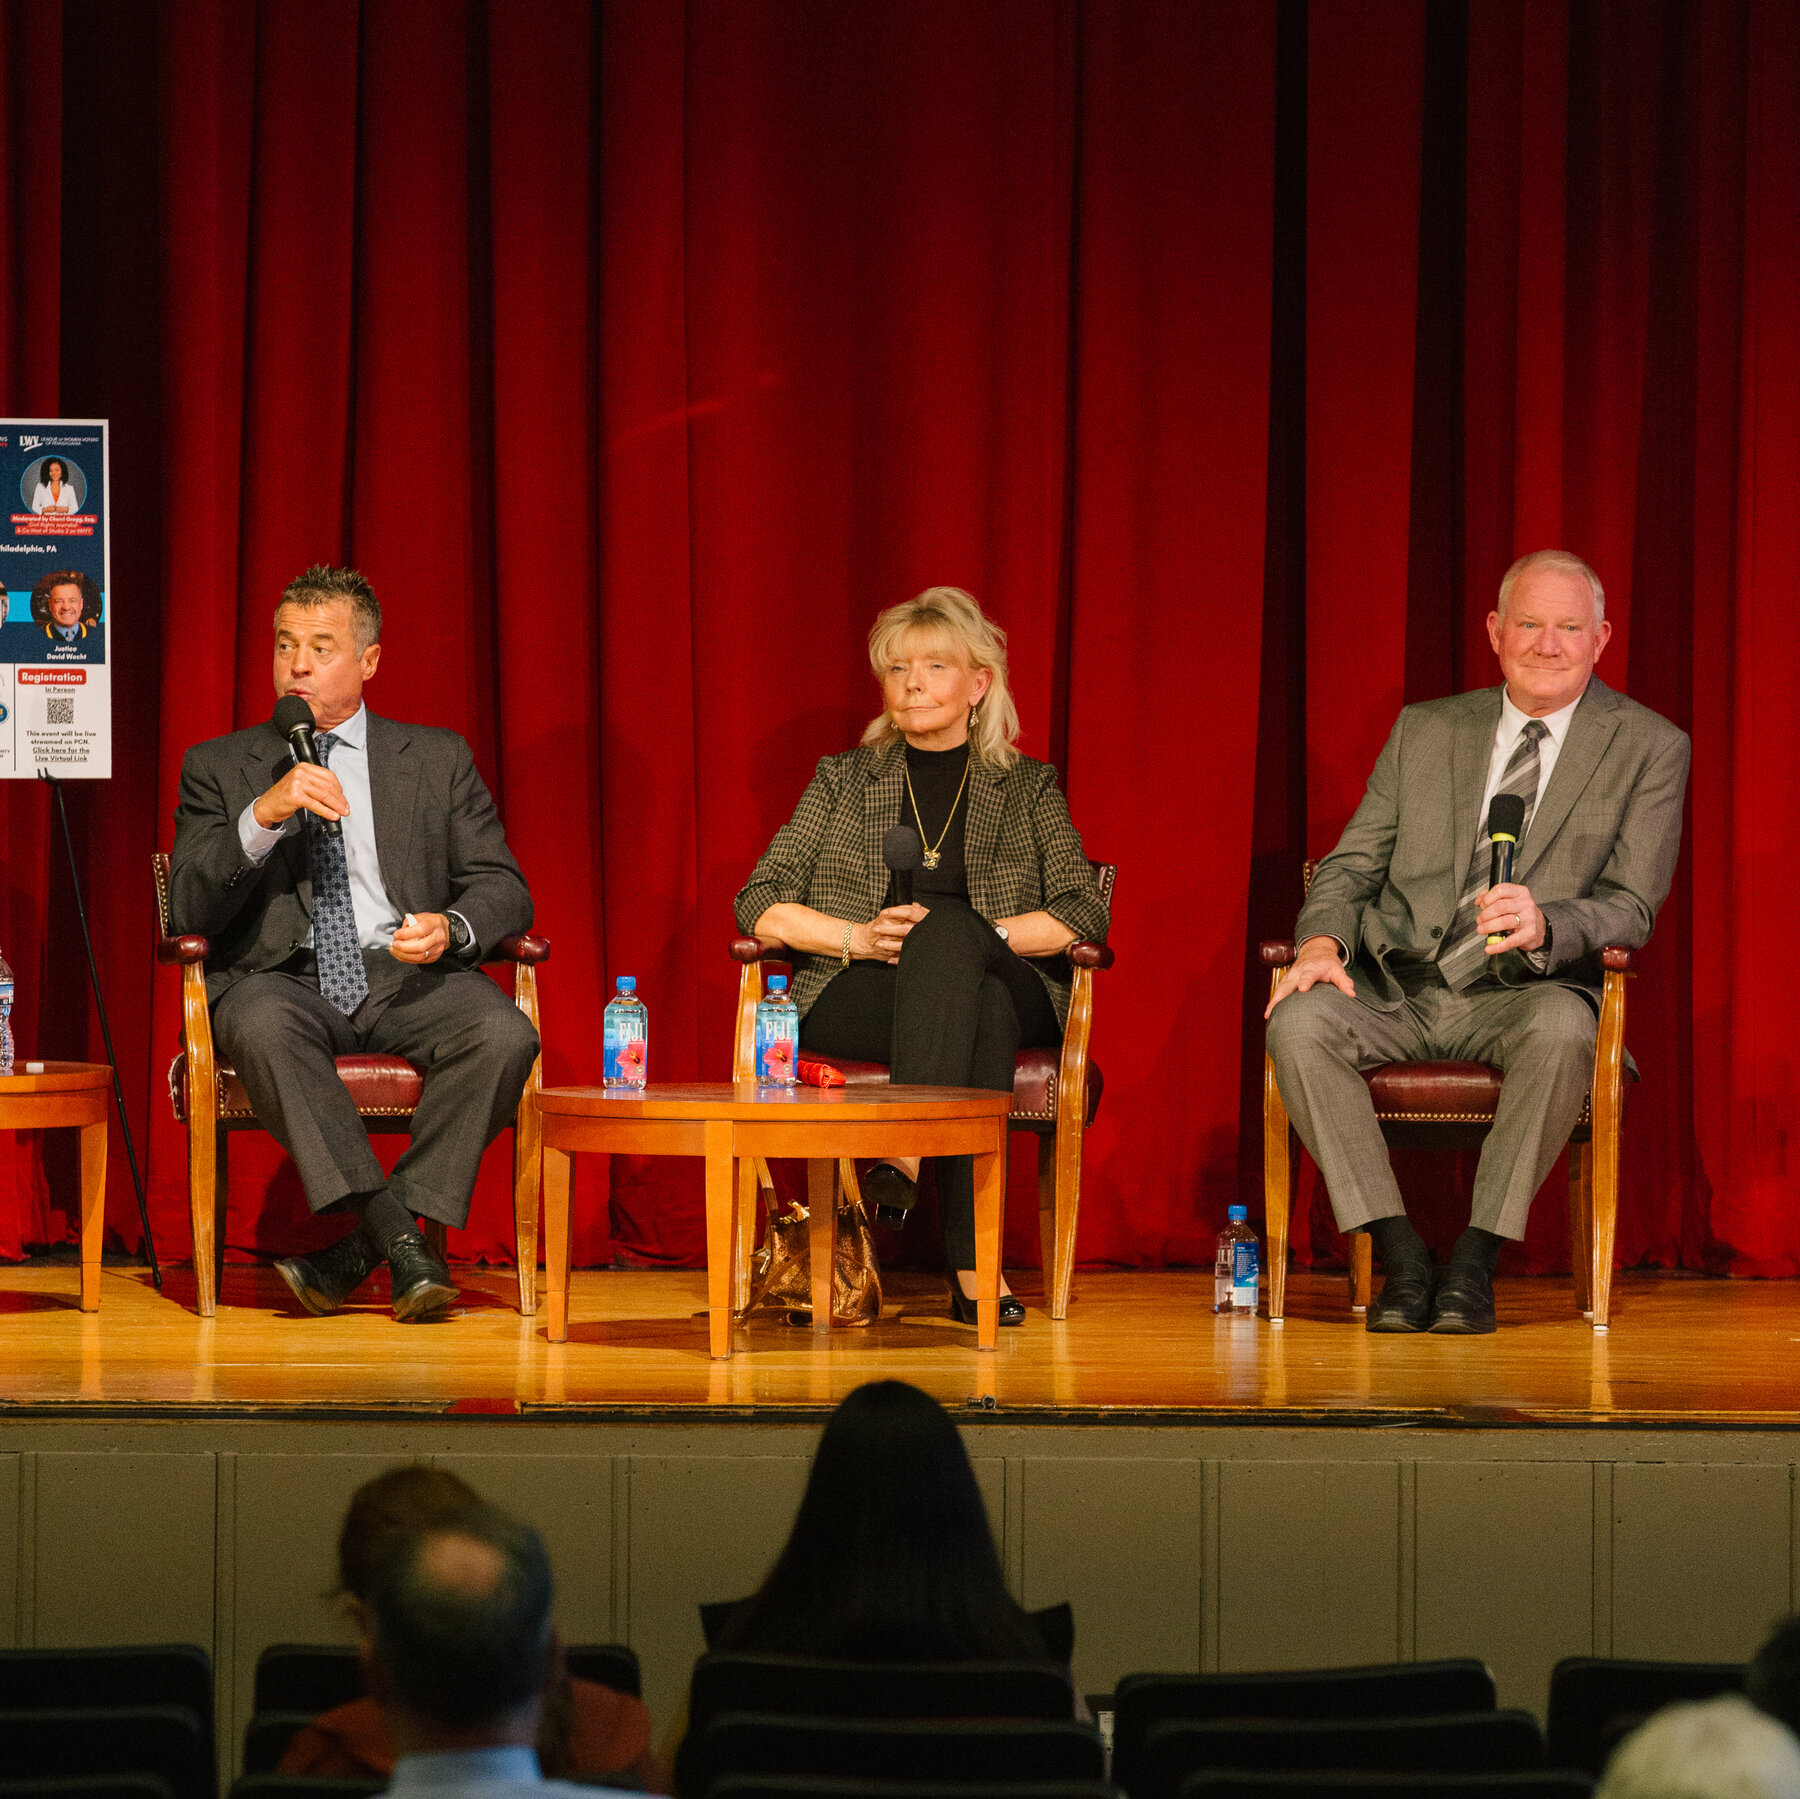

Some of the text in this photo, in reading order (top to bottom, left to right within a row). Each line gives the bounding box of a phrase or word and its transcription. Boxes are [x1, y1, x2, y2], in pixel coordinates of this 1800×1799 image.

[19, 435, 43, 448] LWV
[0, 544, 57, 554] hiladelphia, PA
[21, 672, 83, 684] Registration
[619, 1022, 645, 1041] FIJI
[765, 1021, 791, 1041] FIJI
